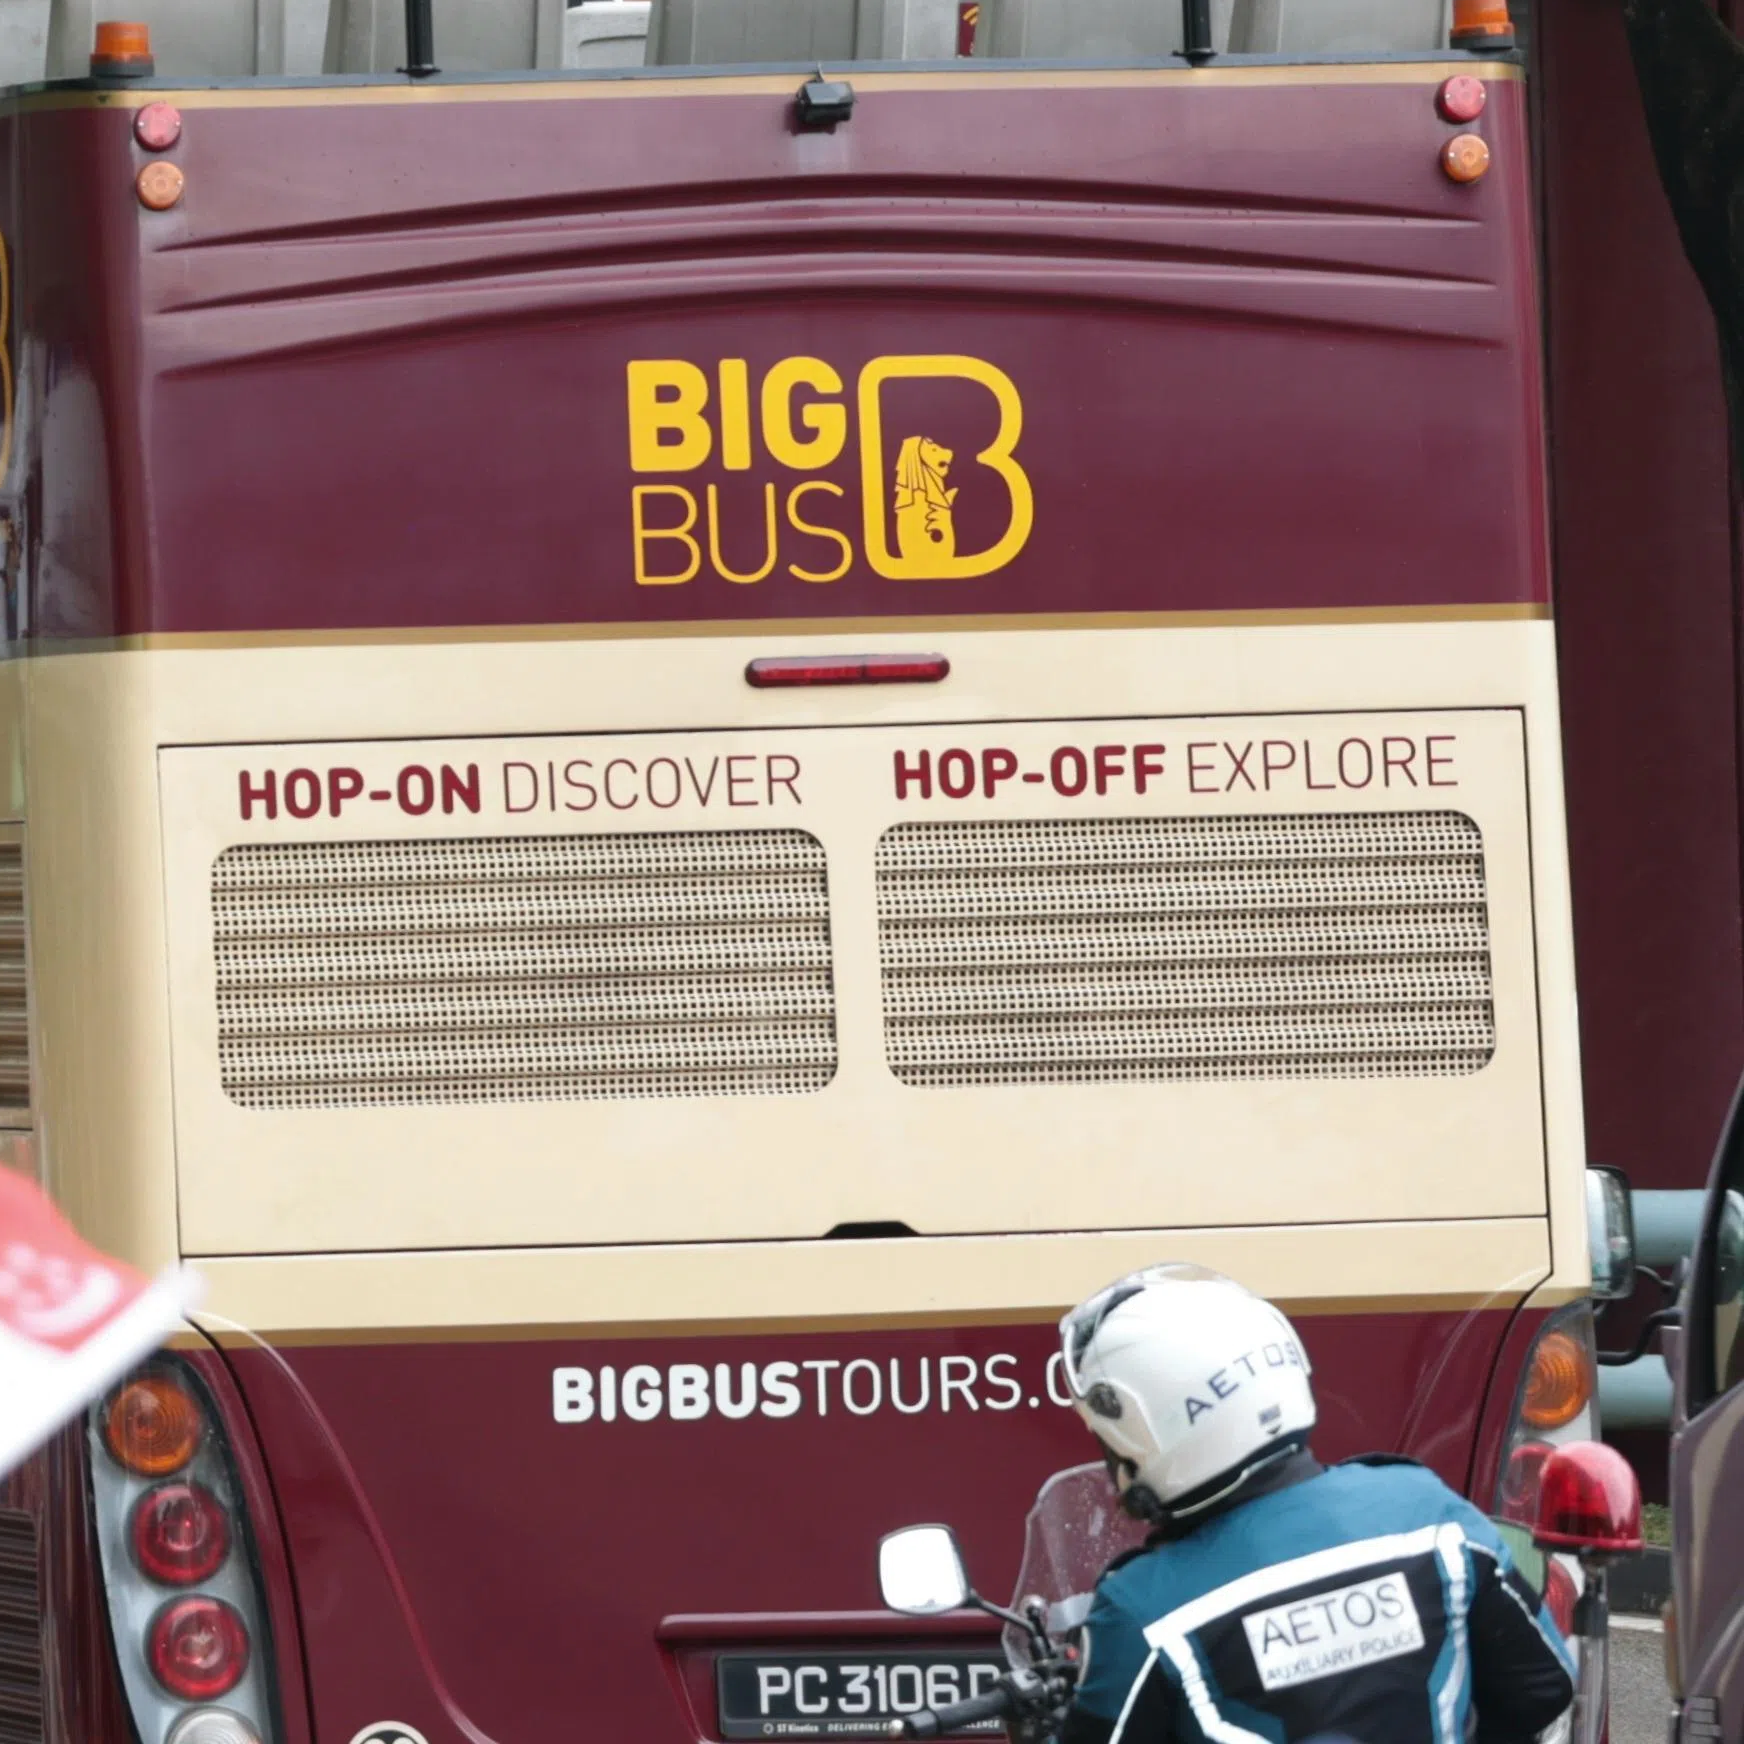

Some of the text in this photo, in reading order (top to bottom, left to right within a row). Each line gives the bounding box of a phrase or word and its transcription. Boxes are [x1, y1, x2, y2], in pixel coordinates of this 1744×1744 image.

[625, 355, 848, 473] BIG
[631, 480, 853, 586] BUS
[238, 754, 802, 821] HOP-ON DISCOVER
[893, 735, 1459, 802] HOP-OFF EXPLORE
[551, 1348, 1074, 1424] BIGBUSTOURS.C
[1183, 1340, 1300, 1426] AETOS
[1262, 1581, 1406, 1655] AETOS
[1266, 1626, 1419, 1684] AUXILIARY POLICE
